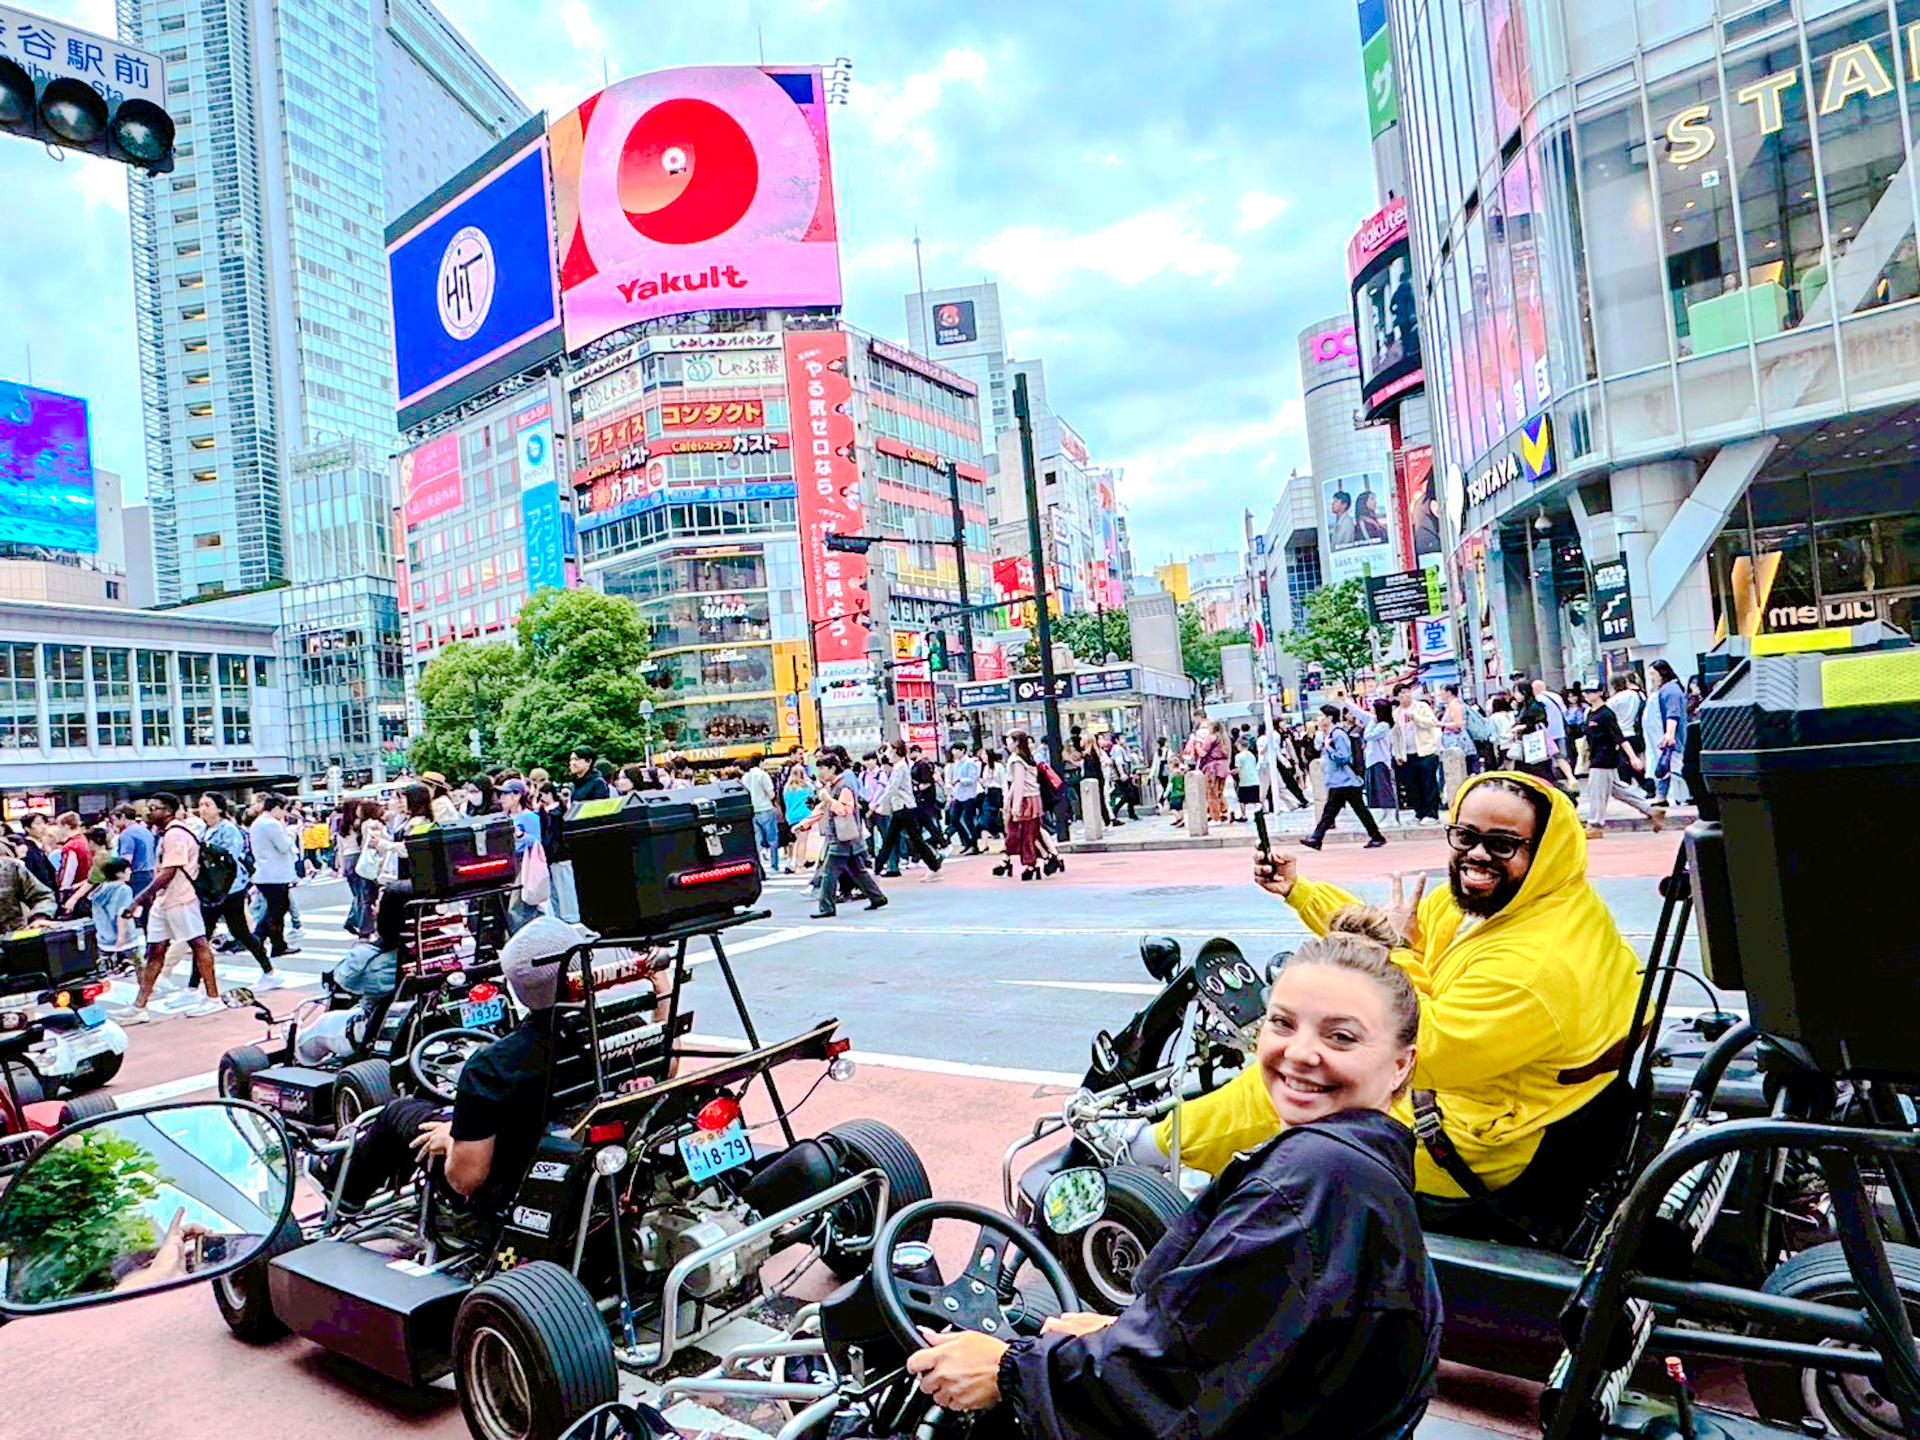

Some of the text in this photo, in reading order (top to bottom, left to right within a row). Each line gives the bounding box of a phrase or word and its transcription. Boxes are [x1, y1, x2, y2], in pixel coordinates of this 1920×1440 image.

[1665, 18, 1920, 165] STA
[1360, 209, 1408, 250] Rakute
[616, 265, 748, 304] Yakult
[670, 334, 775, 349] しゃぶしゃぶバイキング
[718, 354, 779, 375] しゃぶ葉
[662, 402, 762, 425] コンタクト
[733, 434, 778, 455] ガスト
[1467, 452, 1520, 508] TSUTAYA
[1603, 618, 1628, 635] B1F
[703, 1139, 745, 1169] 18-79
